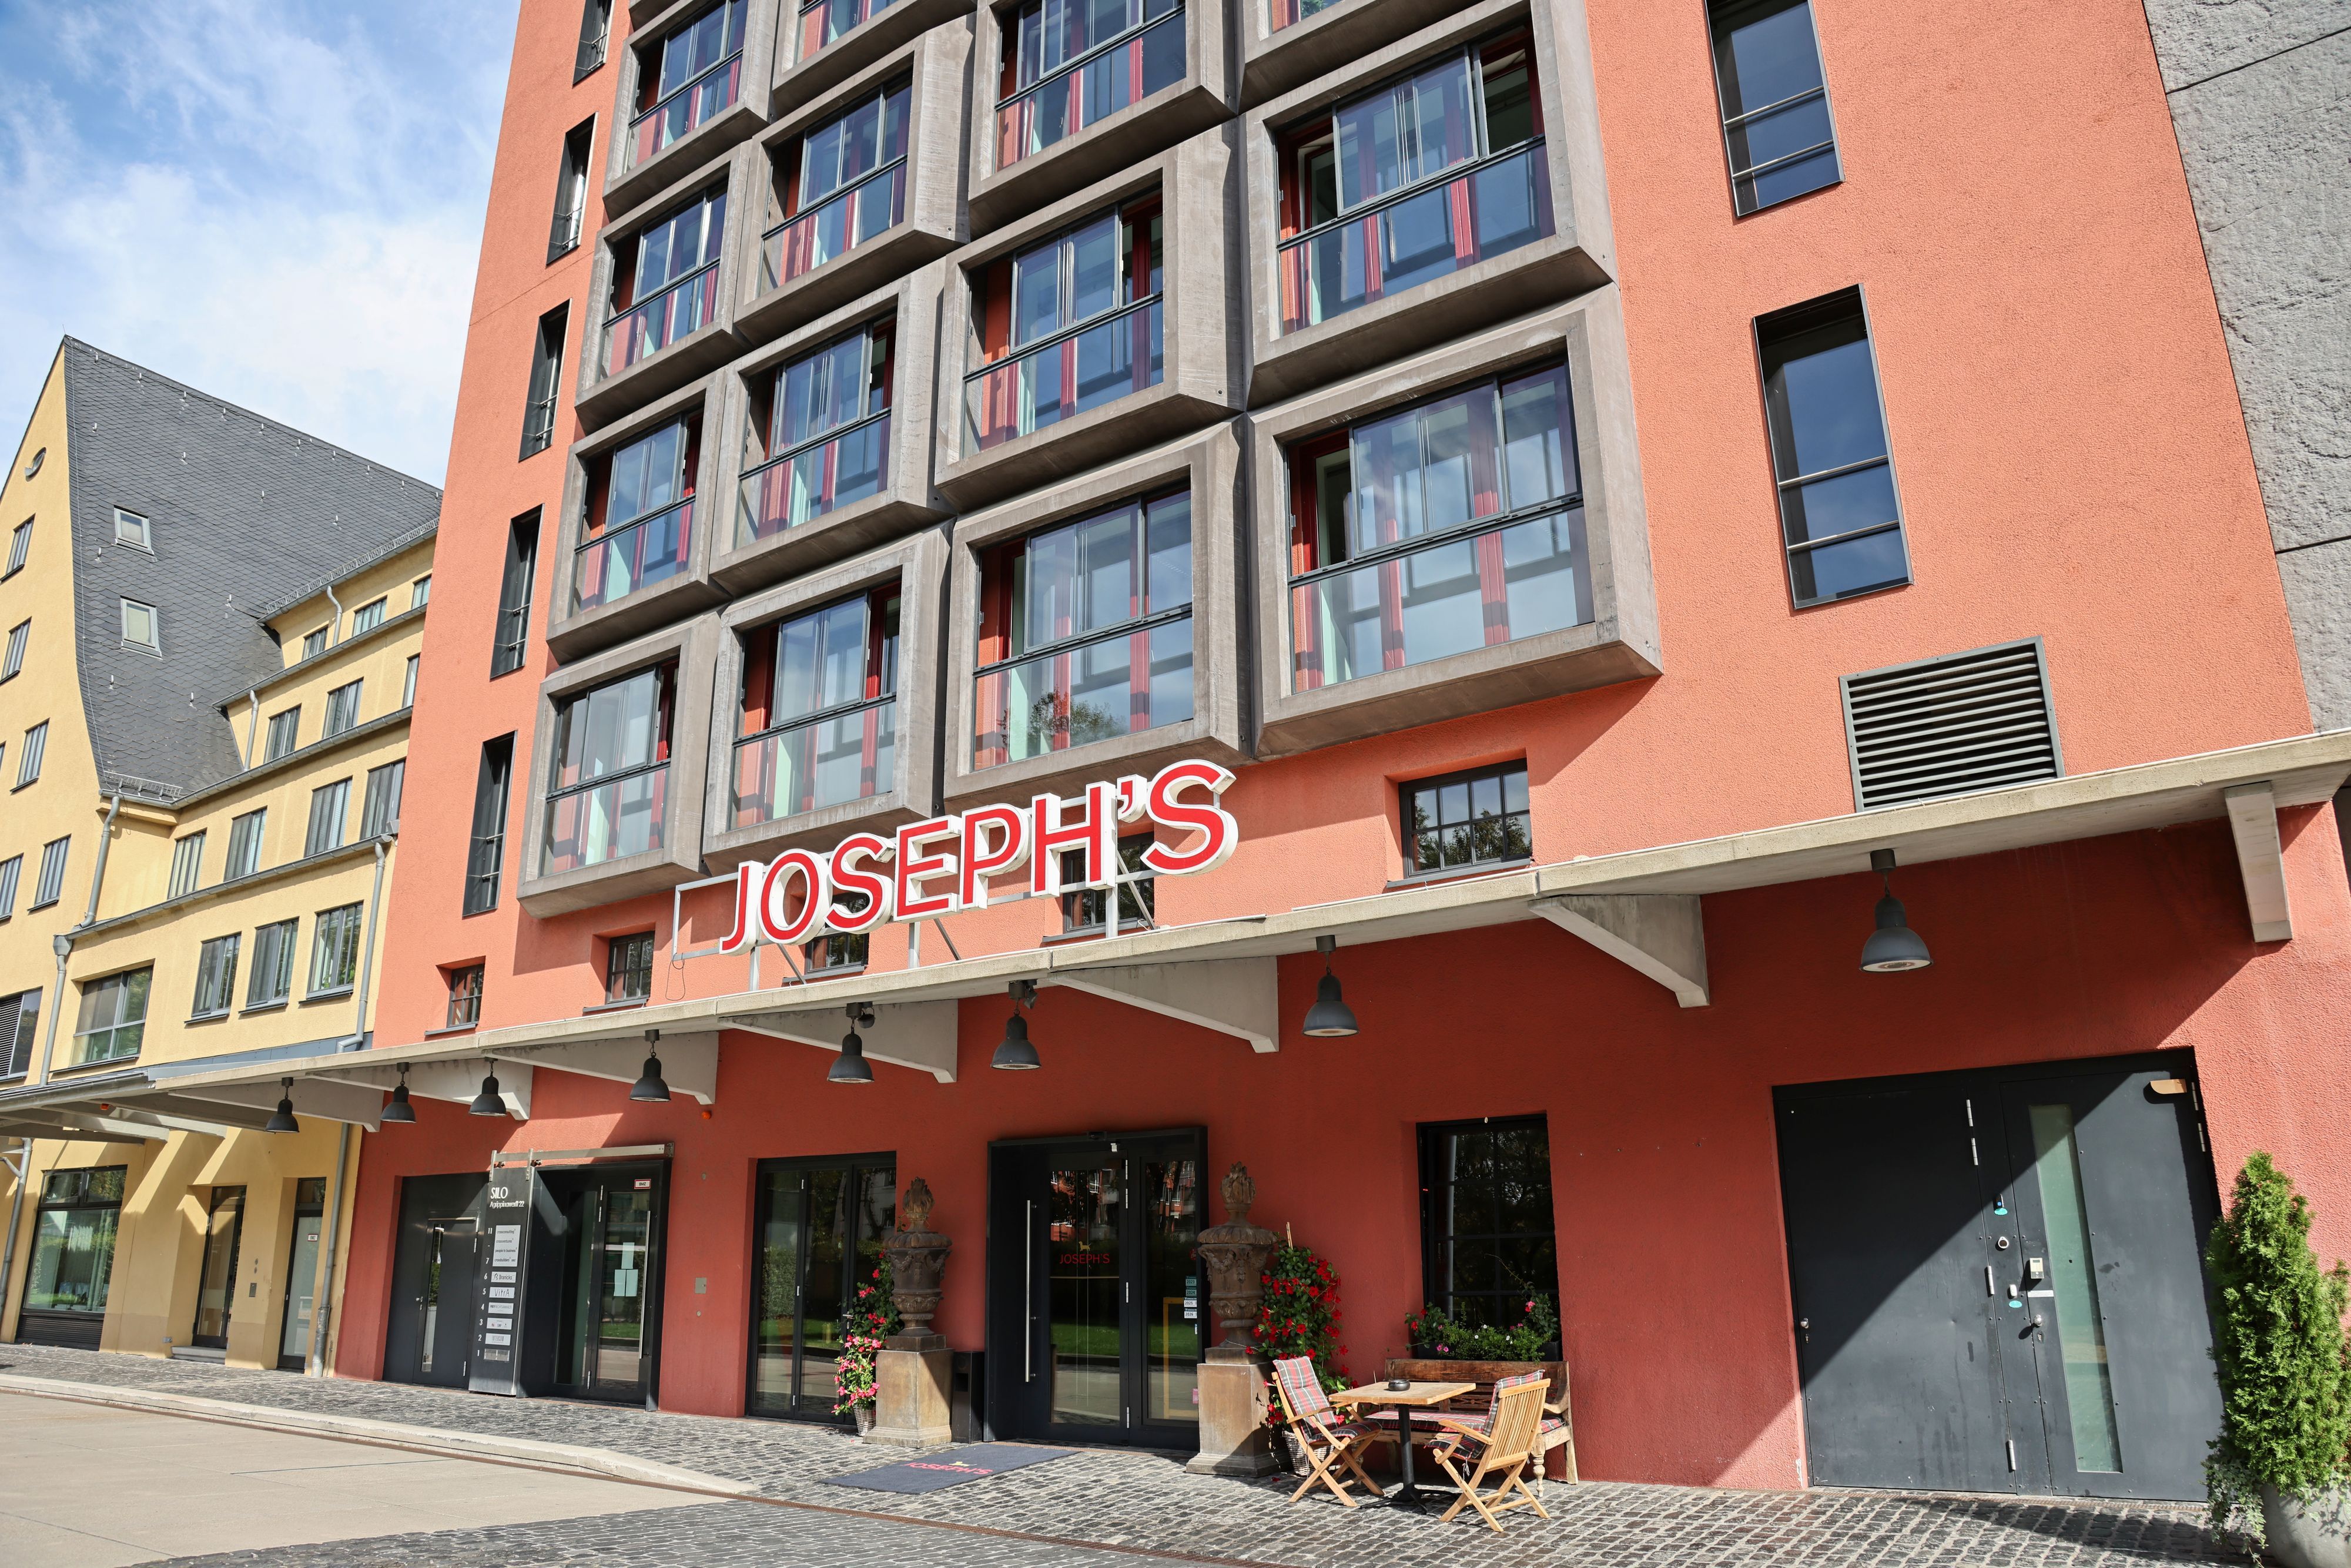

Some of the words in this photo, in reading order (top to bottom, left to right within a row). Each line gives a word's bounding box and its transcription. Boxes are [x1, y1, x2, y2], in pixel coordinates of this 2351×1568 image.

[719, 759, 1238, 956] JOSEPH'S
[490, 1187, 508, 1199] SILO
[1060, 1253, 1110, 1264] JOSEPH'S
[494, 1288, 510, 1296] VitrA
[899, 1462, 993, 1475] JOSEPH'S
